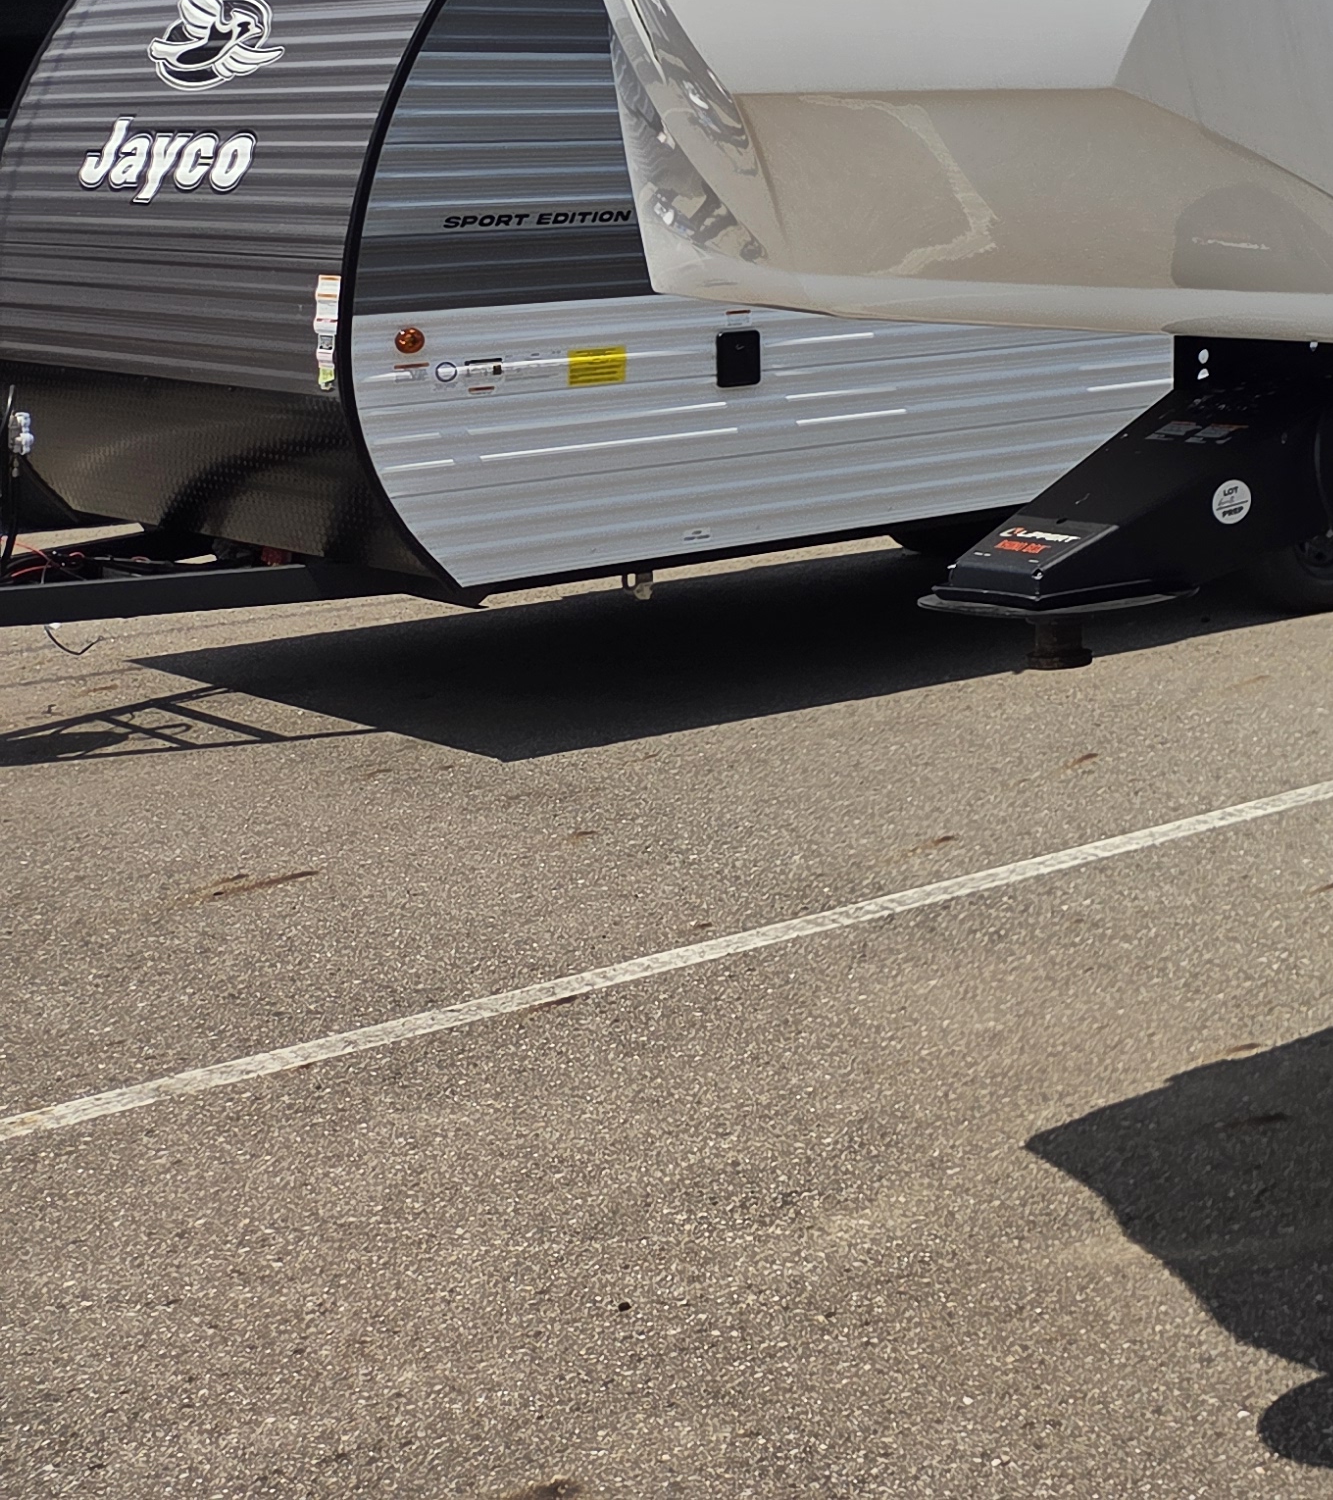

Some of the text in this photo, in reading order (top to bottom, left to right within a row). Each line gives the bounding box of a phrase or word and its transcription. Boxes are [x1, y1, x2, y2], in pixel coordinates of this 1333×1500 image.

[78, 113, 258, 206] Jayco
[442, 210, 632, 229] SPORT EDITION
[1223, 485, 1239, 497] LOT
